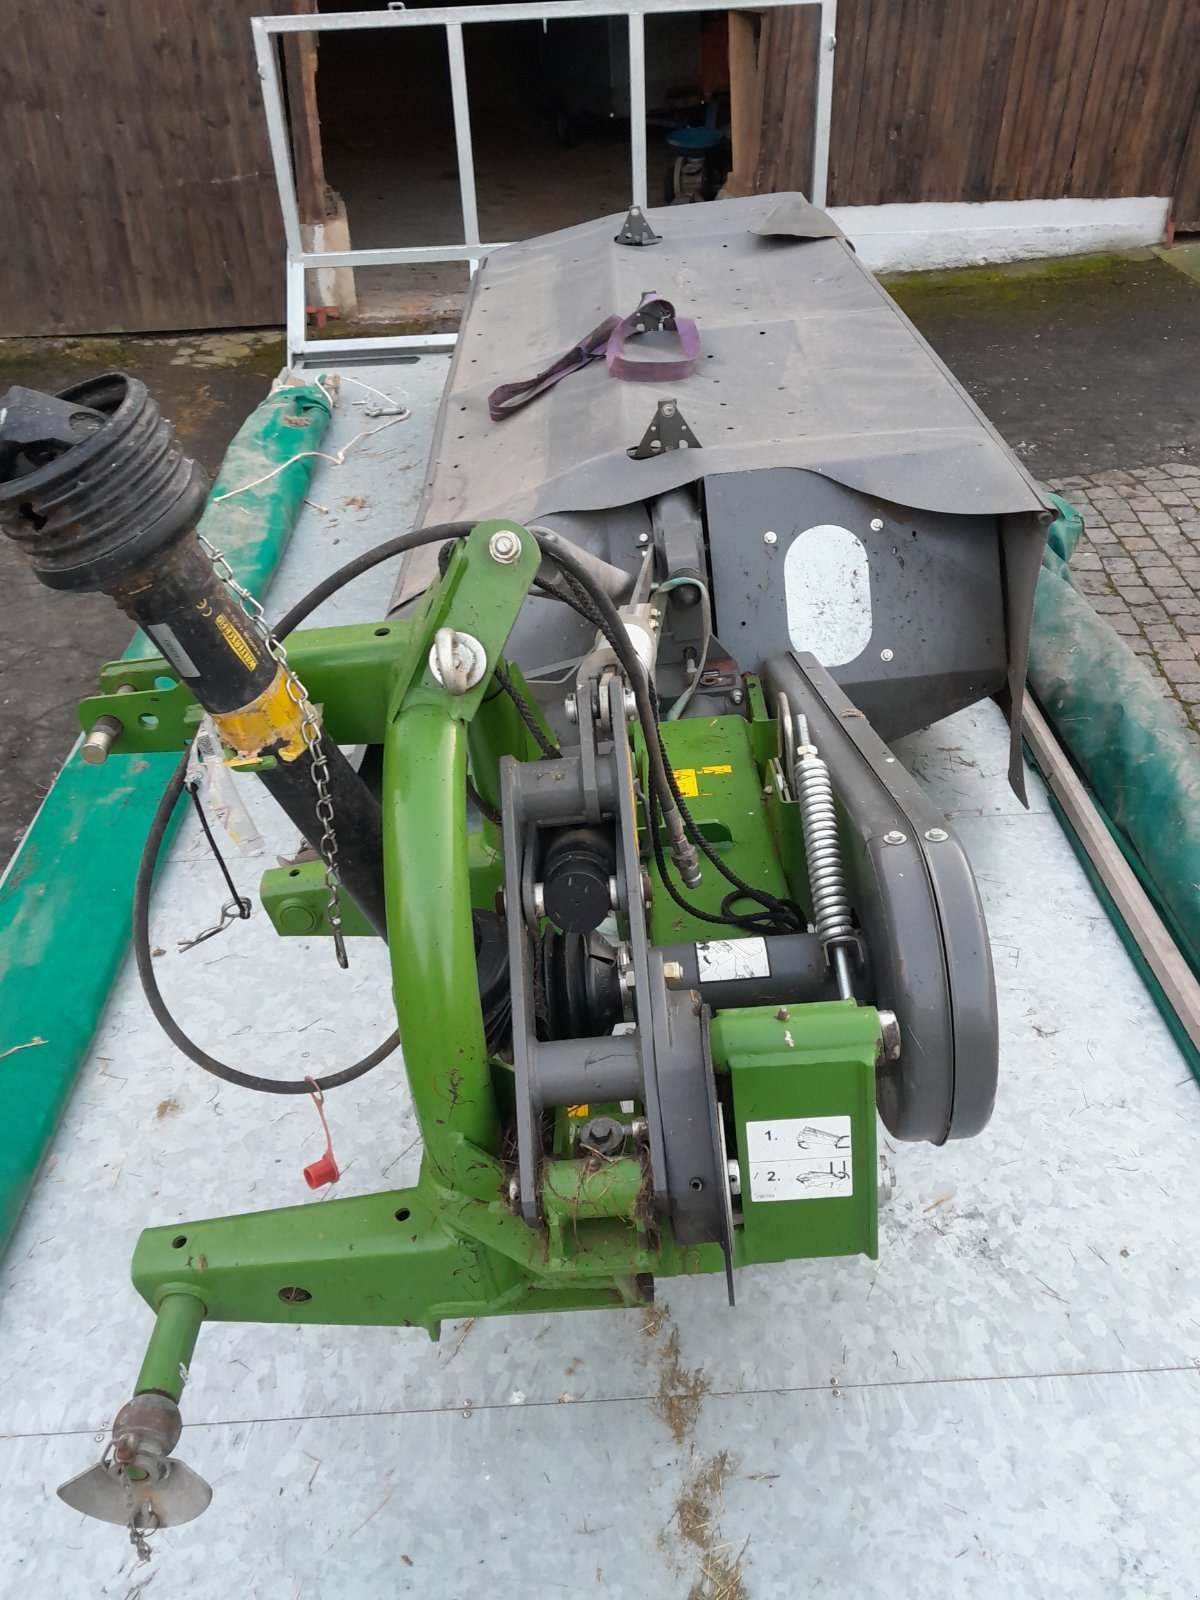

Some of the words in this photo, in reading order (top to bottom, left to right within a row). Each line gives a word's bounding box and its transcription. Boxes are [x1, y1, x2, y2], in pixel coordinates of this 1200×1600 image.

[215, 613, 257, 671] WALTERSCHEID
[764, 1130, 778, 1141] 1.
[767, 1171, 781, 1182] 2.
